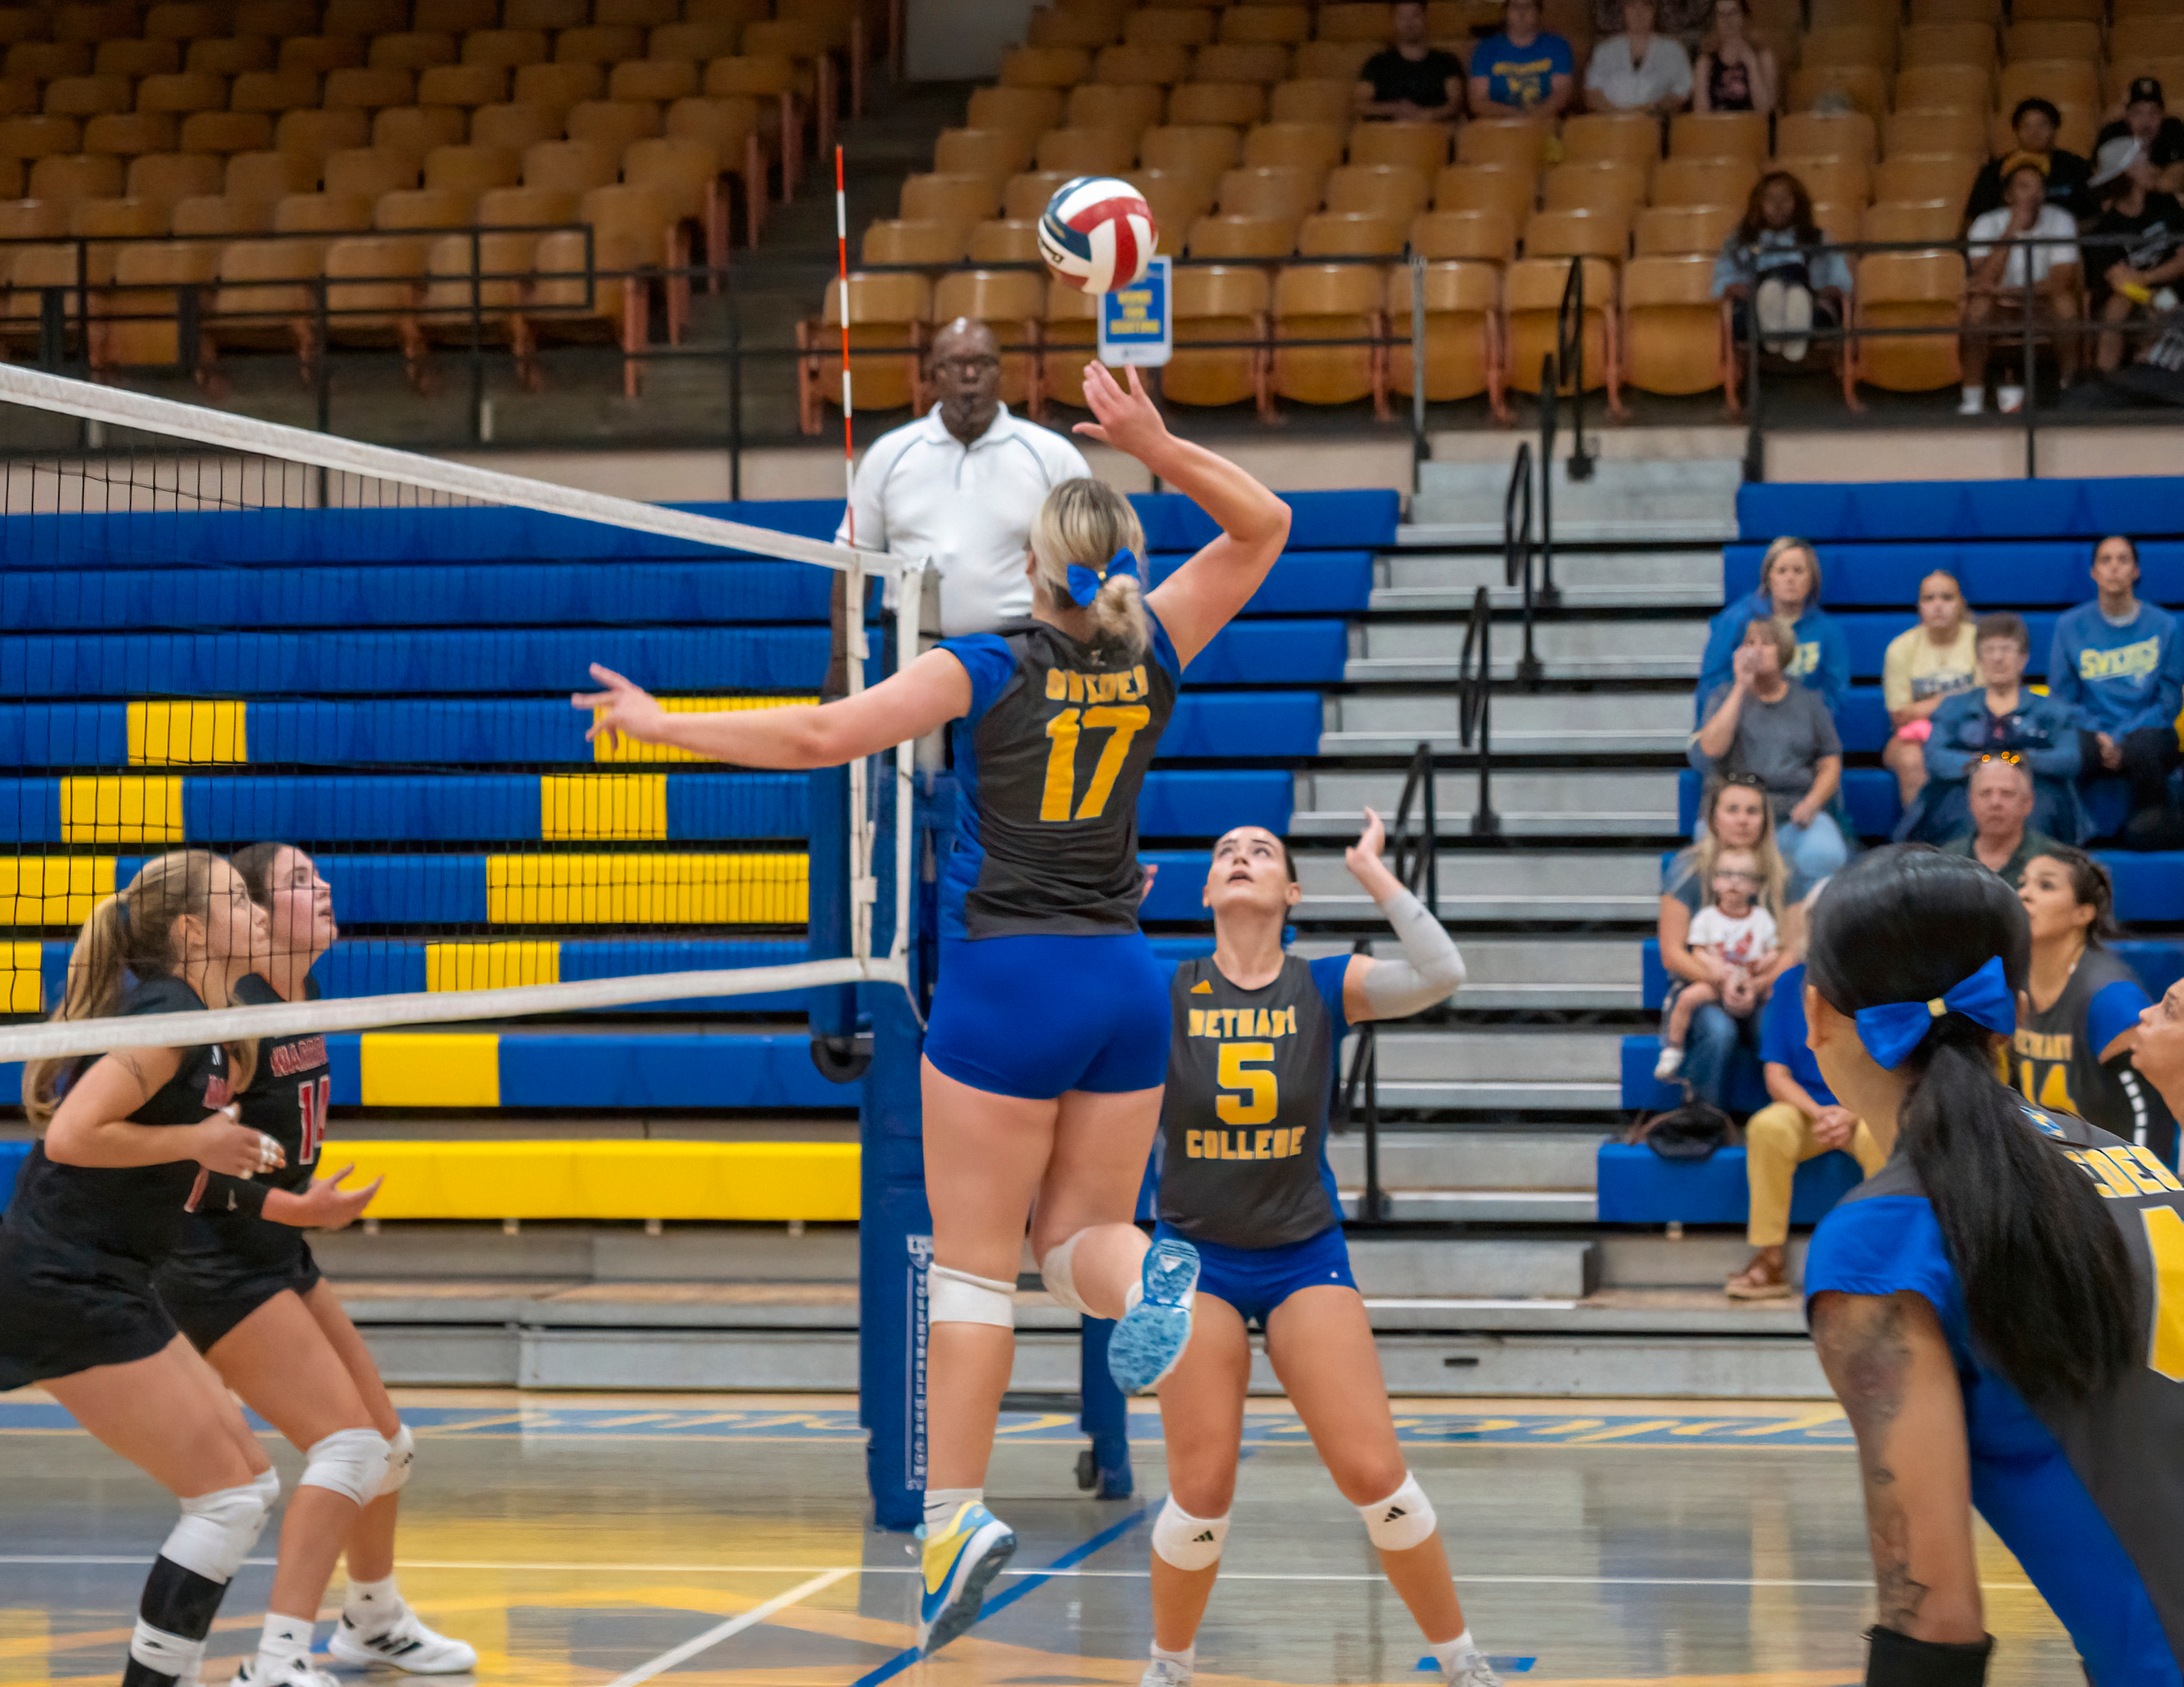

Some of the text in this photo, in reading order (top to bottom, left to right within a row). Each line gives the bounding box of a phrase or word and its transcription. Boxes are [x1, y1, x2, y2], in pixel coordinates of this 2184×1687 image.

[1039, 705, 1151, 822] 17
[1187, 1005, 1297, 1039] BETHANY
[1215, 1042, 1279, 1126] 5
[1186, 1126, 1307, 1160] COLLEGE
